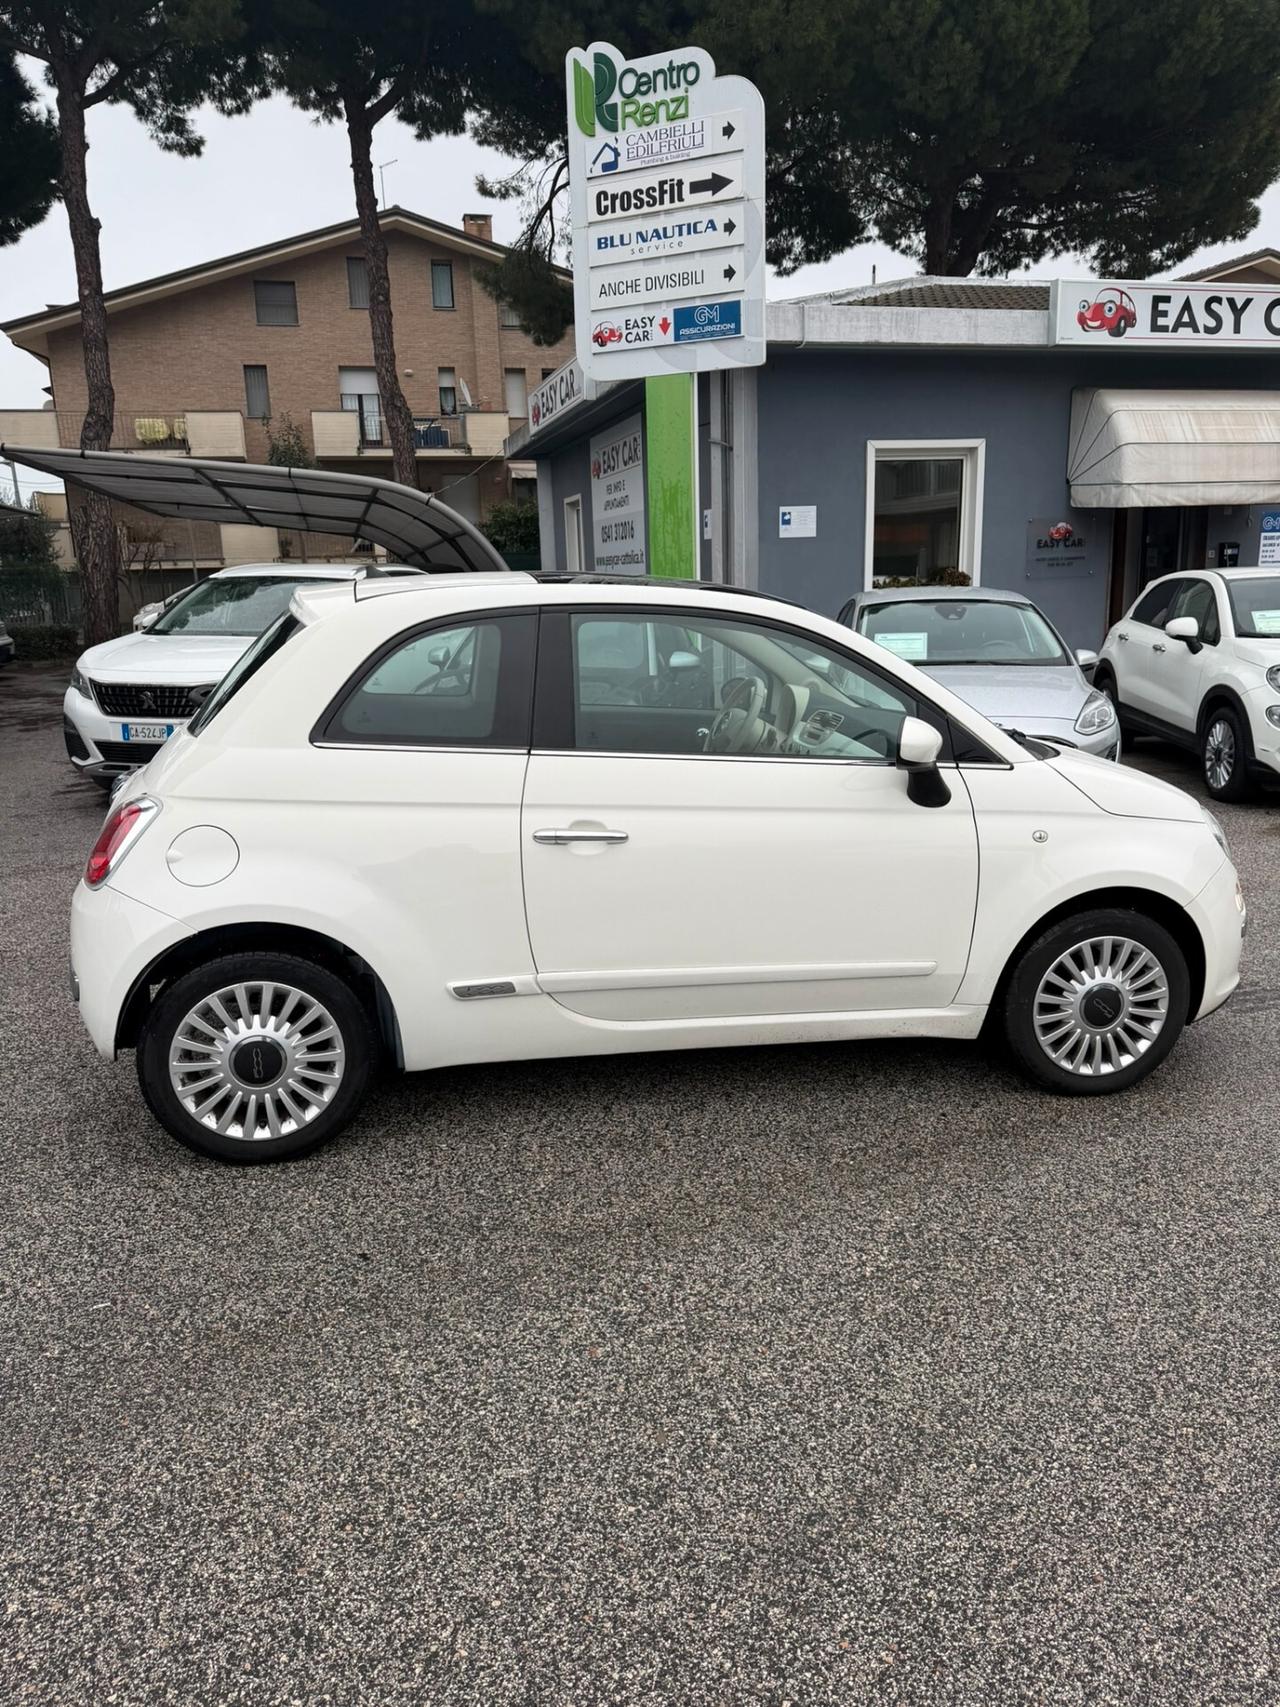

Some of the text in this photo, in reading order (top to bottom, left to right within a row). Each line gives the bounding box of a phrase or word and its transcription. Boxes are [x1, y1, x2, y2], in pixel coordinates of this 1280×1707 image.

[618, 59, 700, 99] Centro
[621, 87, 688, 129] Renzi
[626, 120, 705, 147] CAMBIELLI
[626, 134, 705, 159] EDILFRIULI
[595, 178, 685, 216] CrossFit
[597, 219, 718, 250] BLU NAUTICA
[631, 241, 684, 255] service
[599, 269, 705, 298] ANCHE DIVISIBILI
[625, 316, 656, 331] EASY
[680, 323, 735, 335] ASSICURAZIONI
[1150, 295, 1254, 335] EASY
[625, 329, 651, 344] CAR
[540, 369, 575, 419] EASY CAR
[602, 444, 621, 475] EASY
[622, 436, 639, 467] CAR
[1037, 538, 1083, 549] EASY CAR
